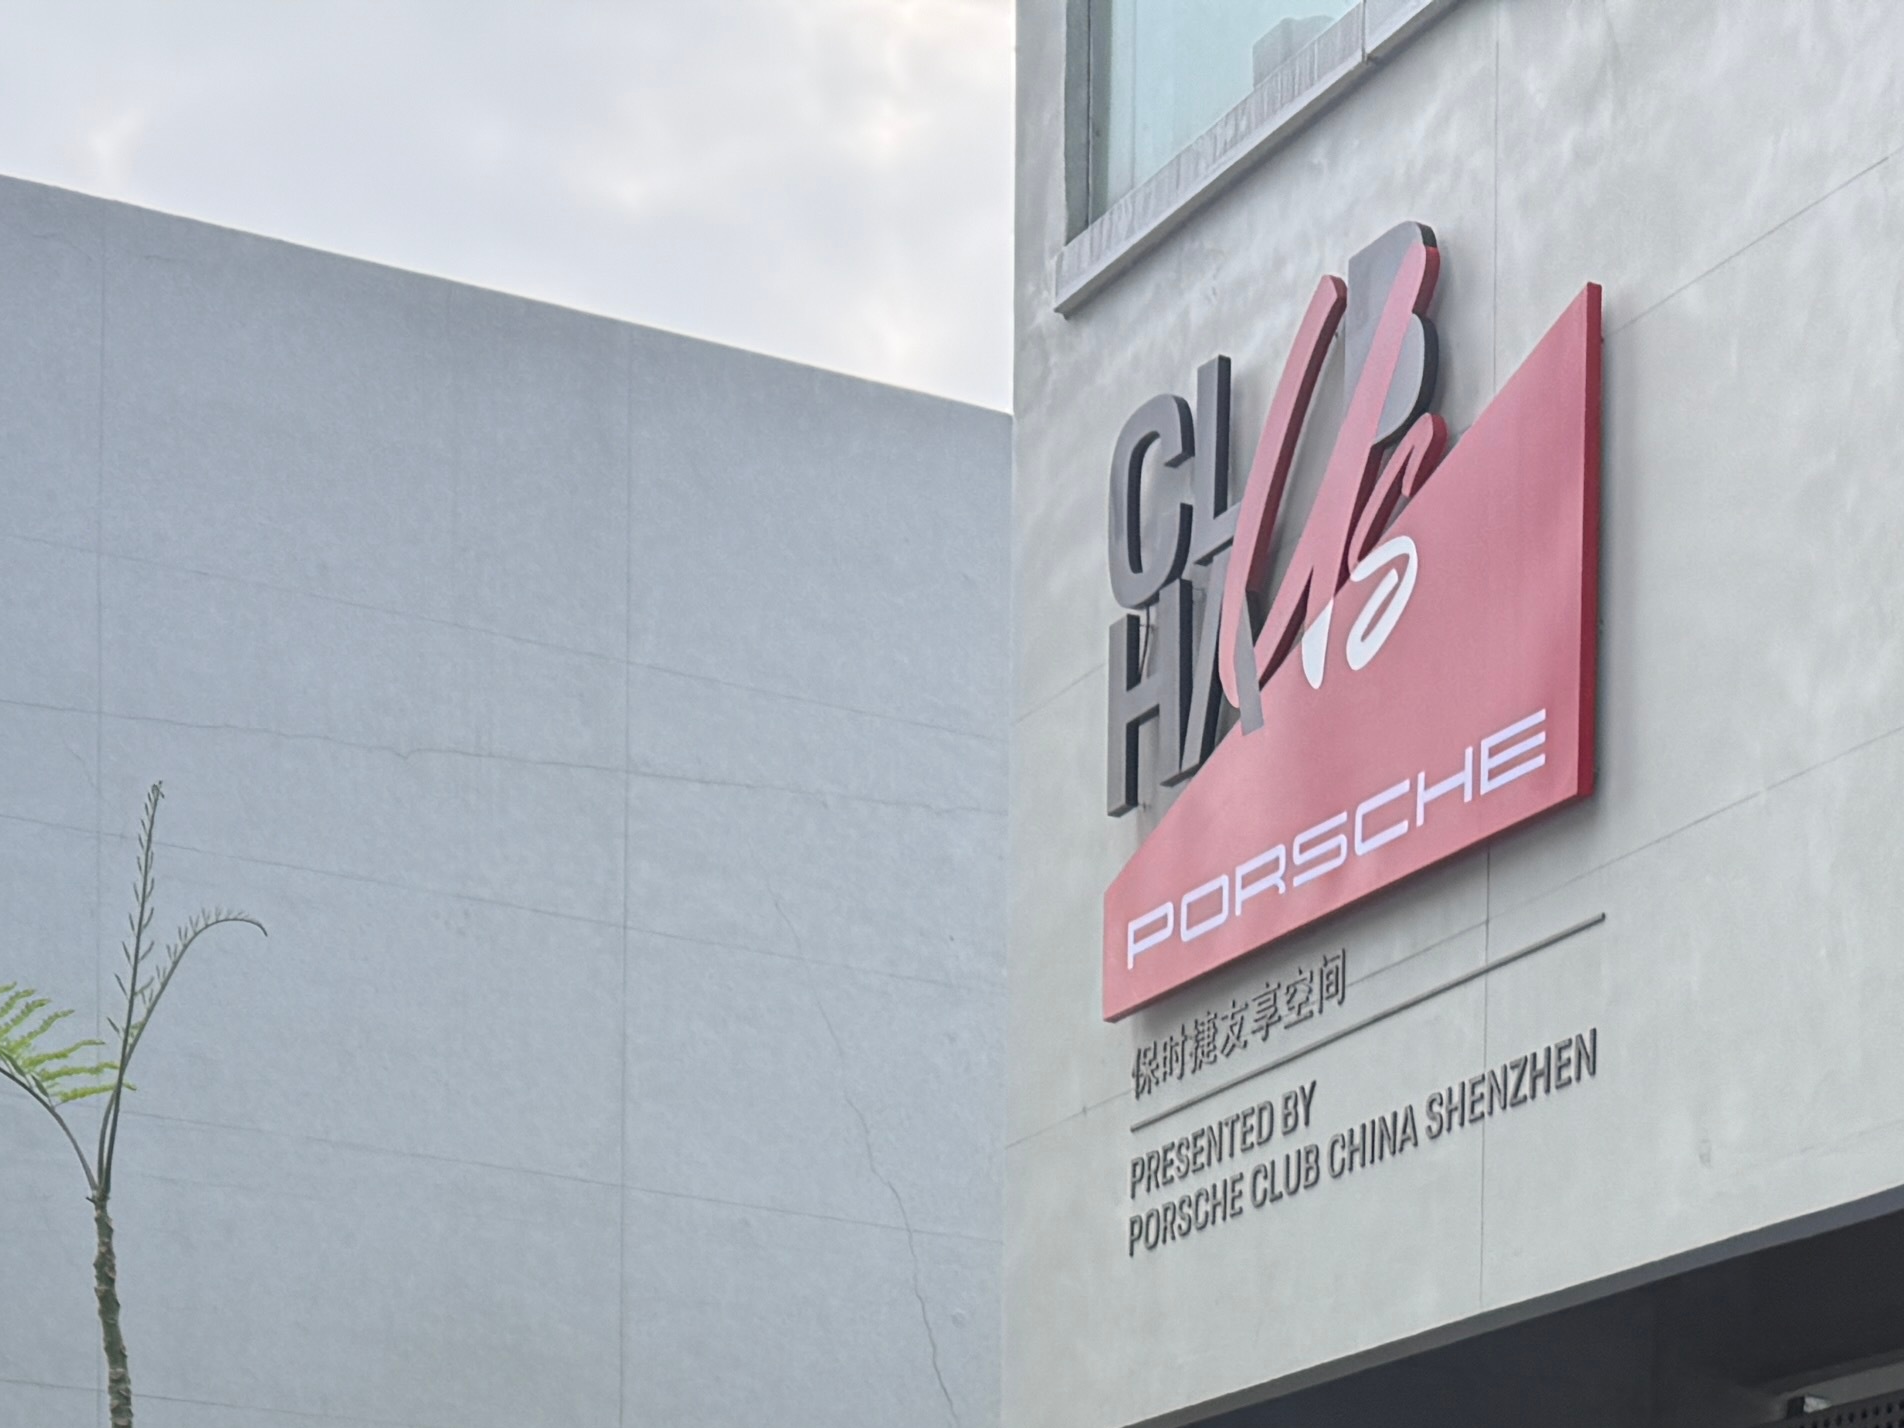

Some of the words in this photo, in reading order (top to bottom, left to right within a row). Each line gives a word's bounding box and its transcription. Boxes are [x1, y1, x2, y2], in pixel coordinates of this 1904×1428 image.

[1126, 708, 1547, 970] PORSCHE
[1131, 947, 1347, 1101] 保时捷友享空间
[1128, 1172, 1245, 1258] PORSCHE
[1249, 1143, 1321, 1209] CLUB
[1328, 1104, 1419, 1180] CHINA
[1426, 1028, 1598, 1140] SHENZHEN
[1129, 1100, 1275, 1200] PRESENTED
[1282, 1080, 1318, 1136] BY
